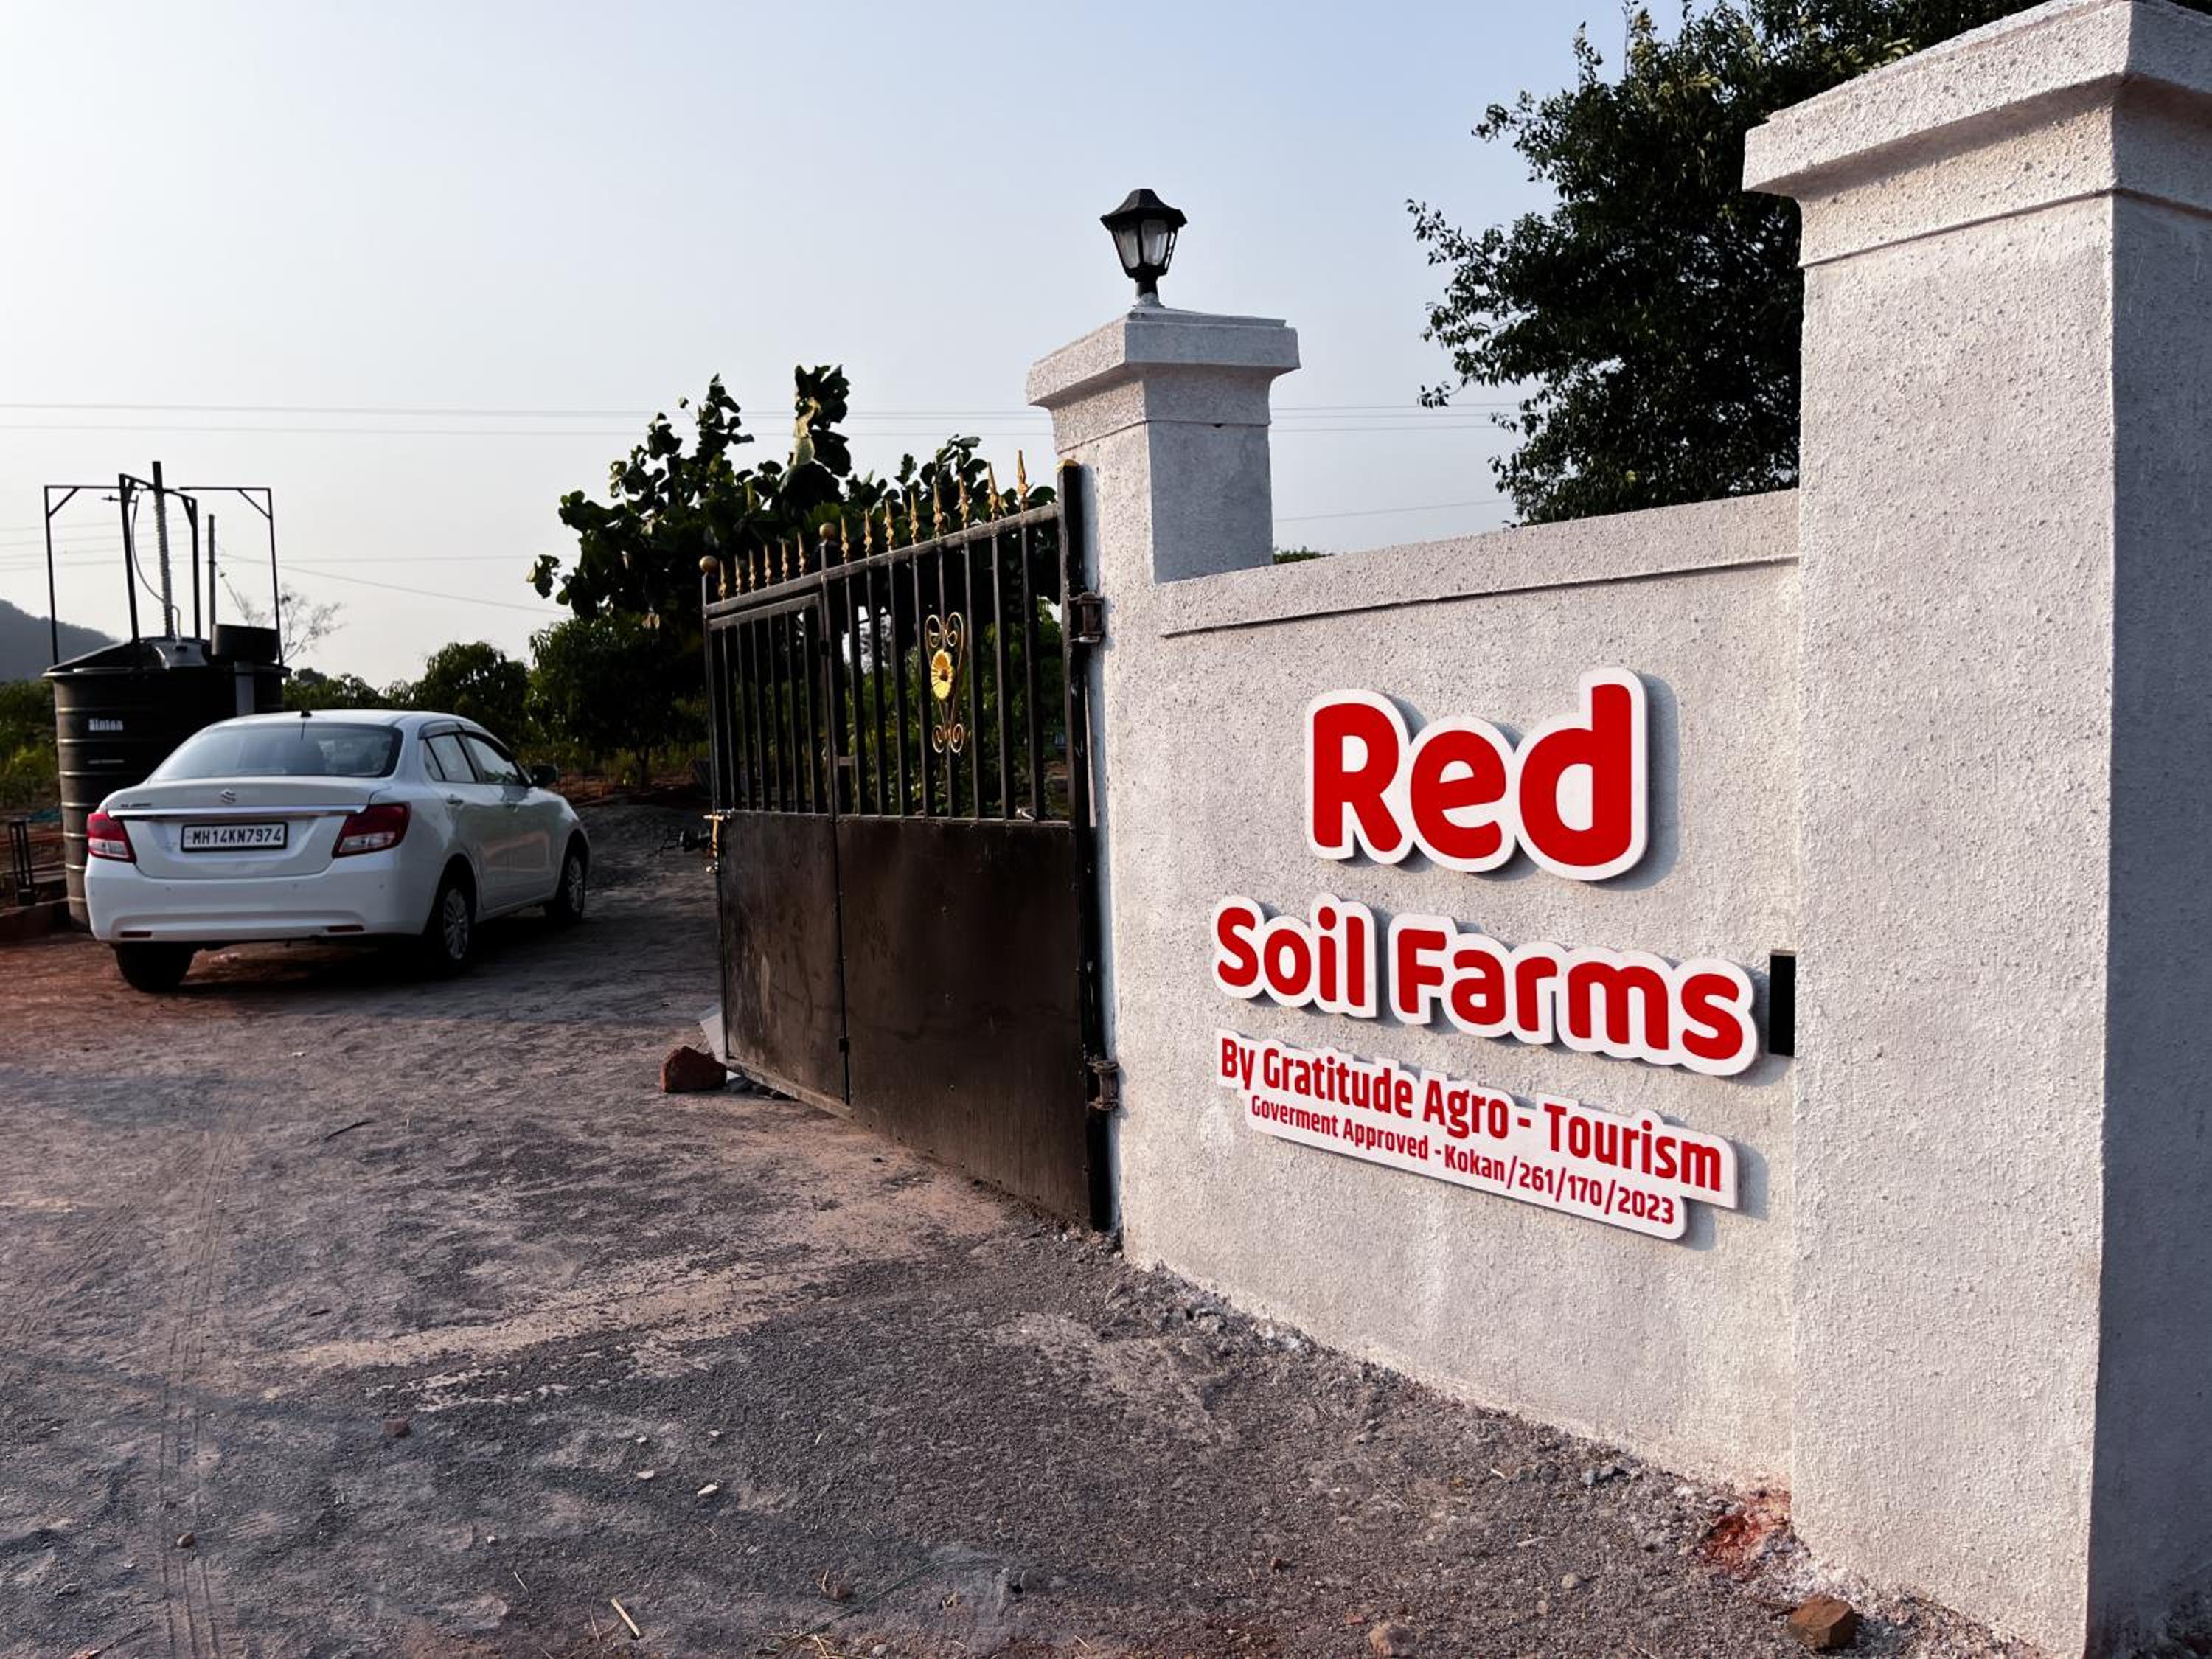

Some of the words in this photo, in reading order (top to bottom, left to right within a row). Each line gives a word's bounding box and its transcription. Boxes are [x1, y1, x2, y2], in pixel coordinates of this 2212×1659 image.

[192, 828, 282, 845] MH14KN7974
[1312, 684, 1632, 867] Red
[1217, 906, 1366, 1008] Soil
[1397, 928, 1745, 1061] Farms
[1221, 1037, 1256, 1091] By
[1262, 1047, 1414, 1119] Gratitude
[1422, 1079, 1509, 1141] Agro
[1543, 1103, 1722, 1192] Tourism
[1251, 1094, 1338, 1138] Goverment
[1343, 1118, 1429, 1161] Approved
